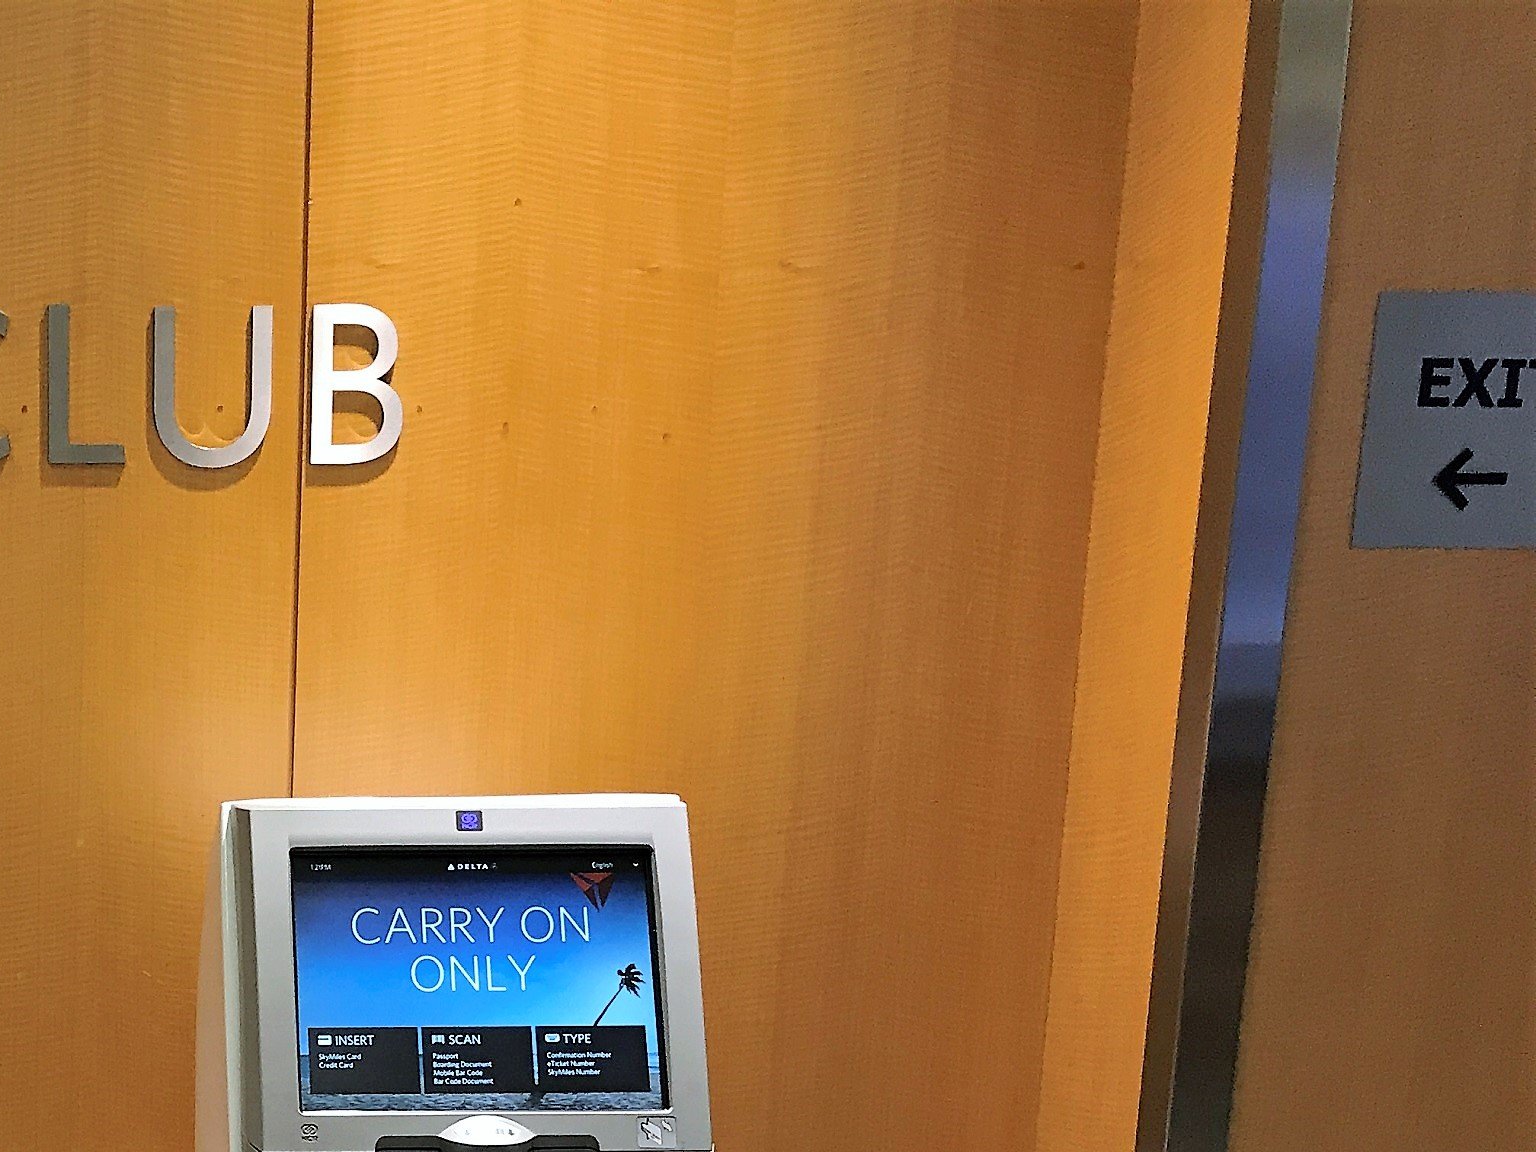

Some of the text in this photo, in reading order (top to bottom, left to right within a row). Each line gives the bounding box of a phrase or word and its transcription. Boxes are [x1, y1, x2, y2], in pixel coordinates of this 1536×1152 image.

[1417, 357, 1536, 408] EXI
[351, 906, 591, 945] CARRY ON
[411, 955, 536, 992] ONLY
[335, 1034, 375, 1046] INSERT
[448, 1034, 481, 1045] SCAN
[563, 1033, 592, 1044] TYPE
[346, 1053, 362, 1062] Card
[576, 1069, 601, 1077] Number
